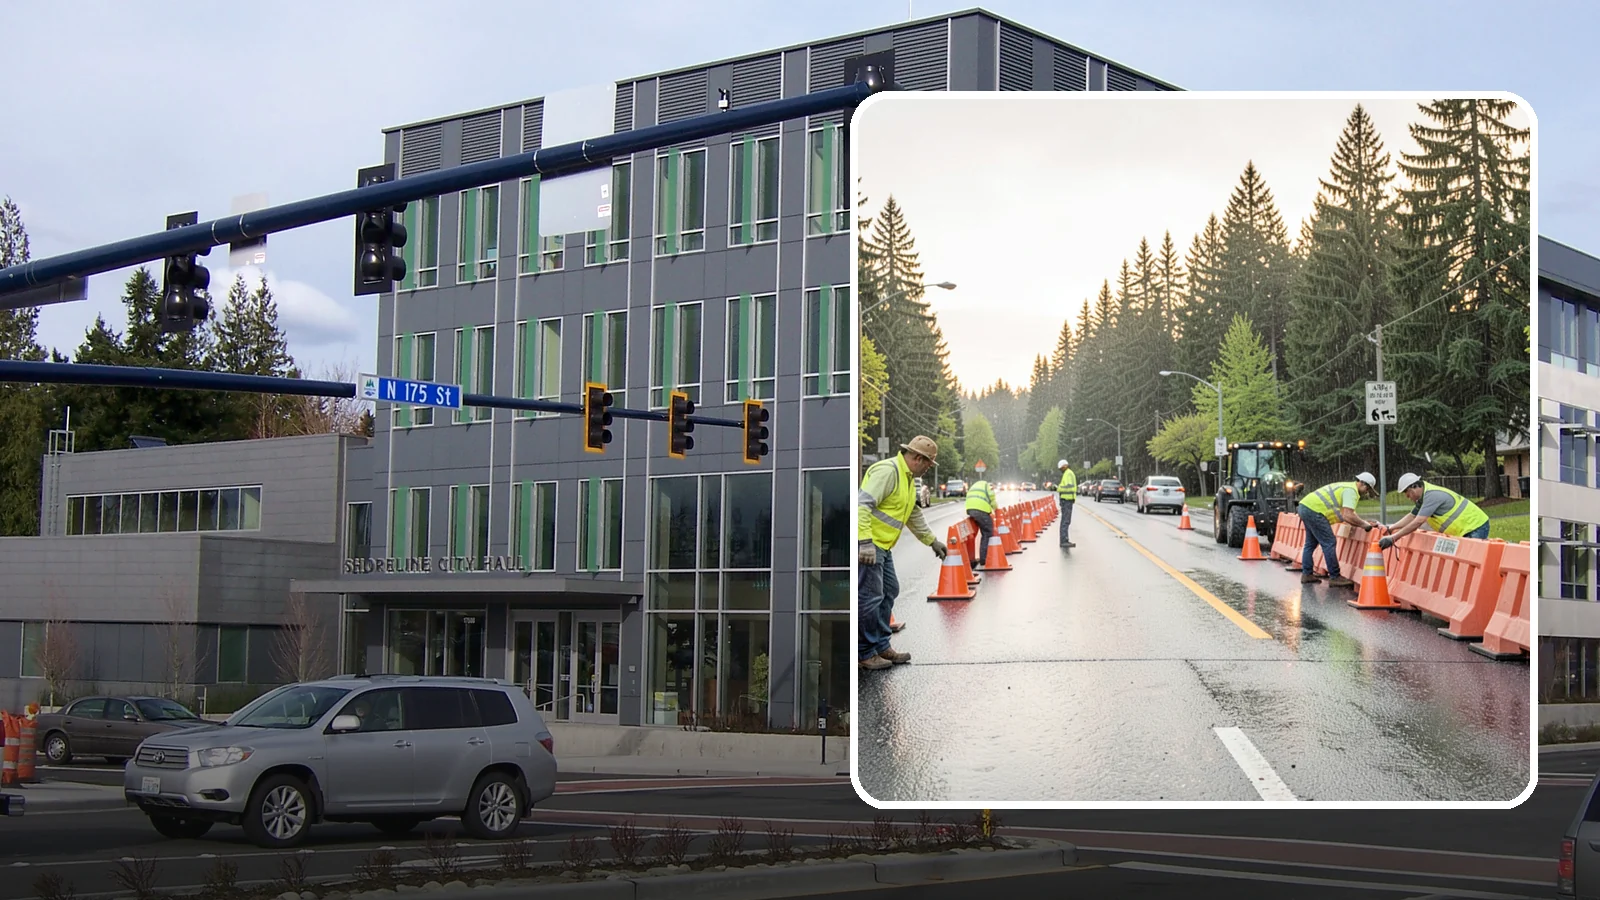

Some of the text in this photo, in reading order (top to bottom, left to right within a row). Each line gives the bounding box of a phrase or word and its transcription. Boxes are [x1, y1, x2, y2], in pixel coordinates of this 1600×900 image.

[387, 380, 451, 406] N 175 St
[344, 555, 525, 574] SHORELINE CITY HALL
